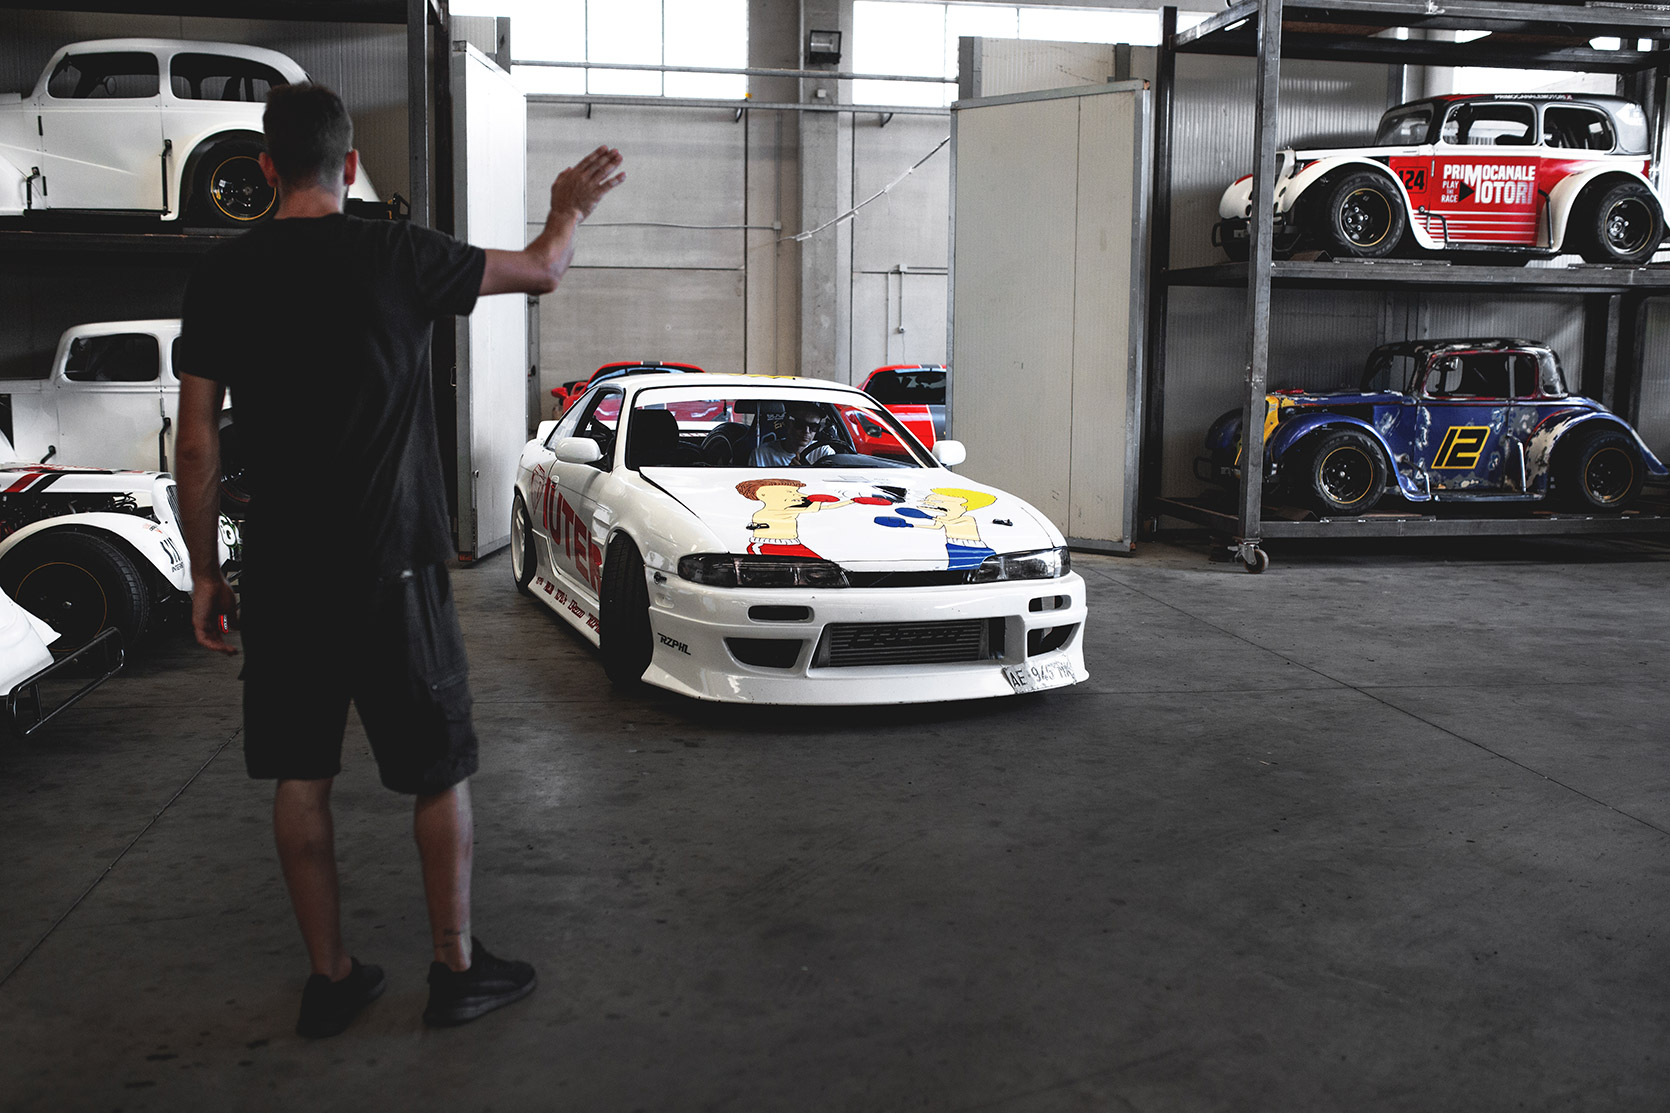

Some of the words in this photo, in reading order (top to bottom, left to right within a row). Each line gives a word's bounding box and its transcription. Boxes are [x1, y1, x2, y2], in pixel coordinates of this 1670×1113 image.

[1443, 164, 1536, 184] PRIMOCANALE
[1442, 181, 1459, 189] PLAY
[1441, 195, 1458, 203] RACE
[1431, 426, 1491, 469] 12
[1009, 669, 1027, 687] AE
